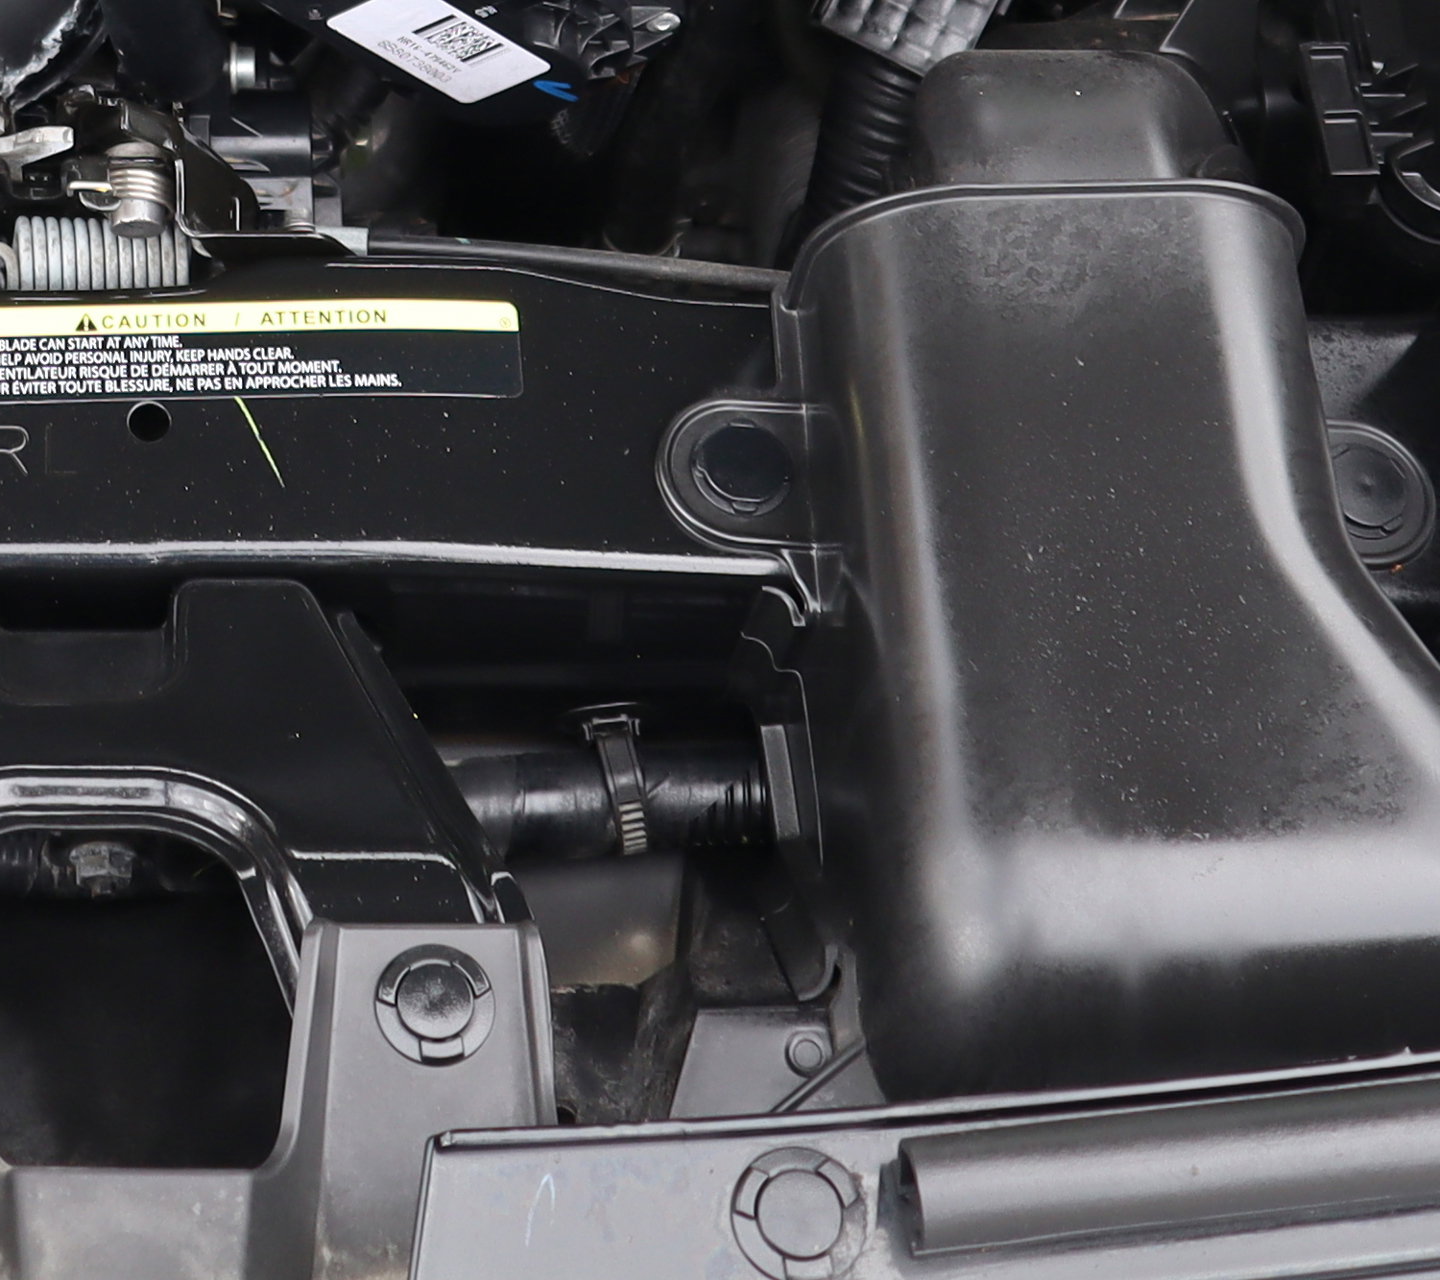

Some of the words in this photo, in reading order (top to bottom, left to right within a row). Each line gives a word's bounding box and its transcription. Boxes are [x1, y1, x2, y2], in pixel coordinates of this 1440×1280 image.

[101, 313, 207, 329] CAUTION
[260, 310, 387, 326] ATTENTION
[39, 338, 66, 351] CAN
[69, 337, 104, 350] START
[107, 337, 122, 349] AT
[123, 336, 149, 348] ANY
[150, 335, 183, 348] TIME.
[24, 352, 62, 366] AVOID
[65, 351, 128, 365] PERSONAL
[130, 350, 174, 365] INJURY,
[176, 349, 205, 362] KEEP
[207, 347, 251, 361] HANDS
[253, 346, 294, 360] CLEAR.
[79, 365, 128, 379] RISQUE
[130, 365, 149, 378] DE
[155, 361, 225, 377] DÉMARRER
[227, 360, 238, 375] À
[239, 361, 275, 375] TOUT
[277, 360, 343, 374] MOMENT.
[12, 379, 57, 395] ÉVITER
[58, 380, 102, 394] TOUTE
[105, 378, 174, 393] BLESSURE,
[176, 378, 195, 391] NE
[197, 377, 222, 390] PAS
[224, 376, 243, 389] EN
[245, 375, 327, 388] APPROCHER
[328, 374, 352, 387] LES
[354, 373, 402, 387] MAINS.
